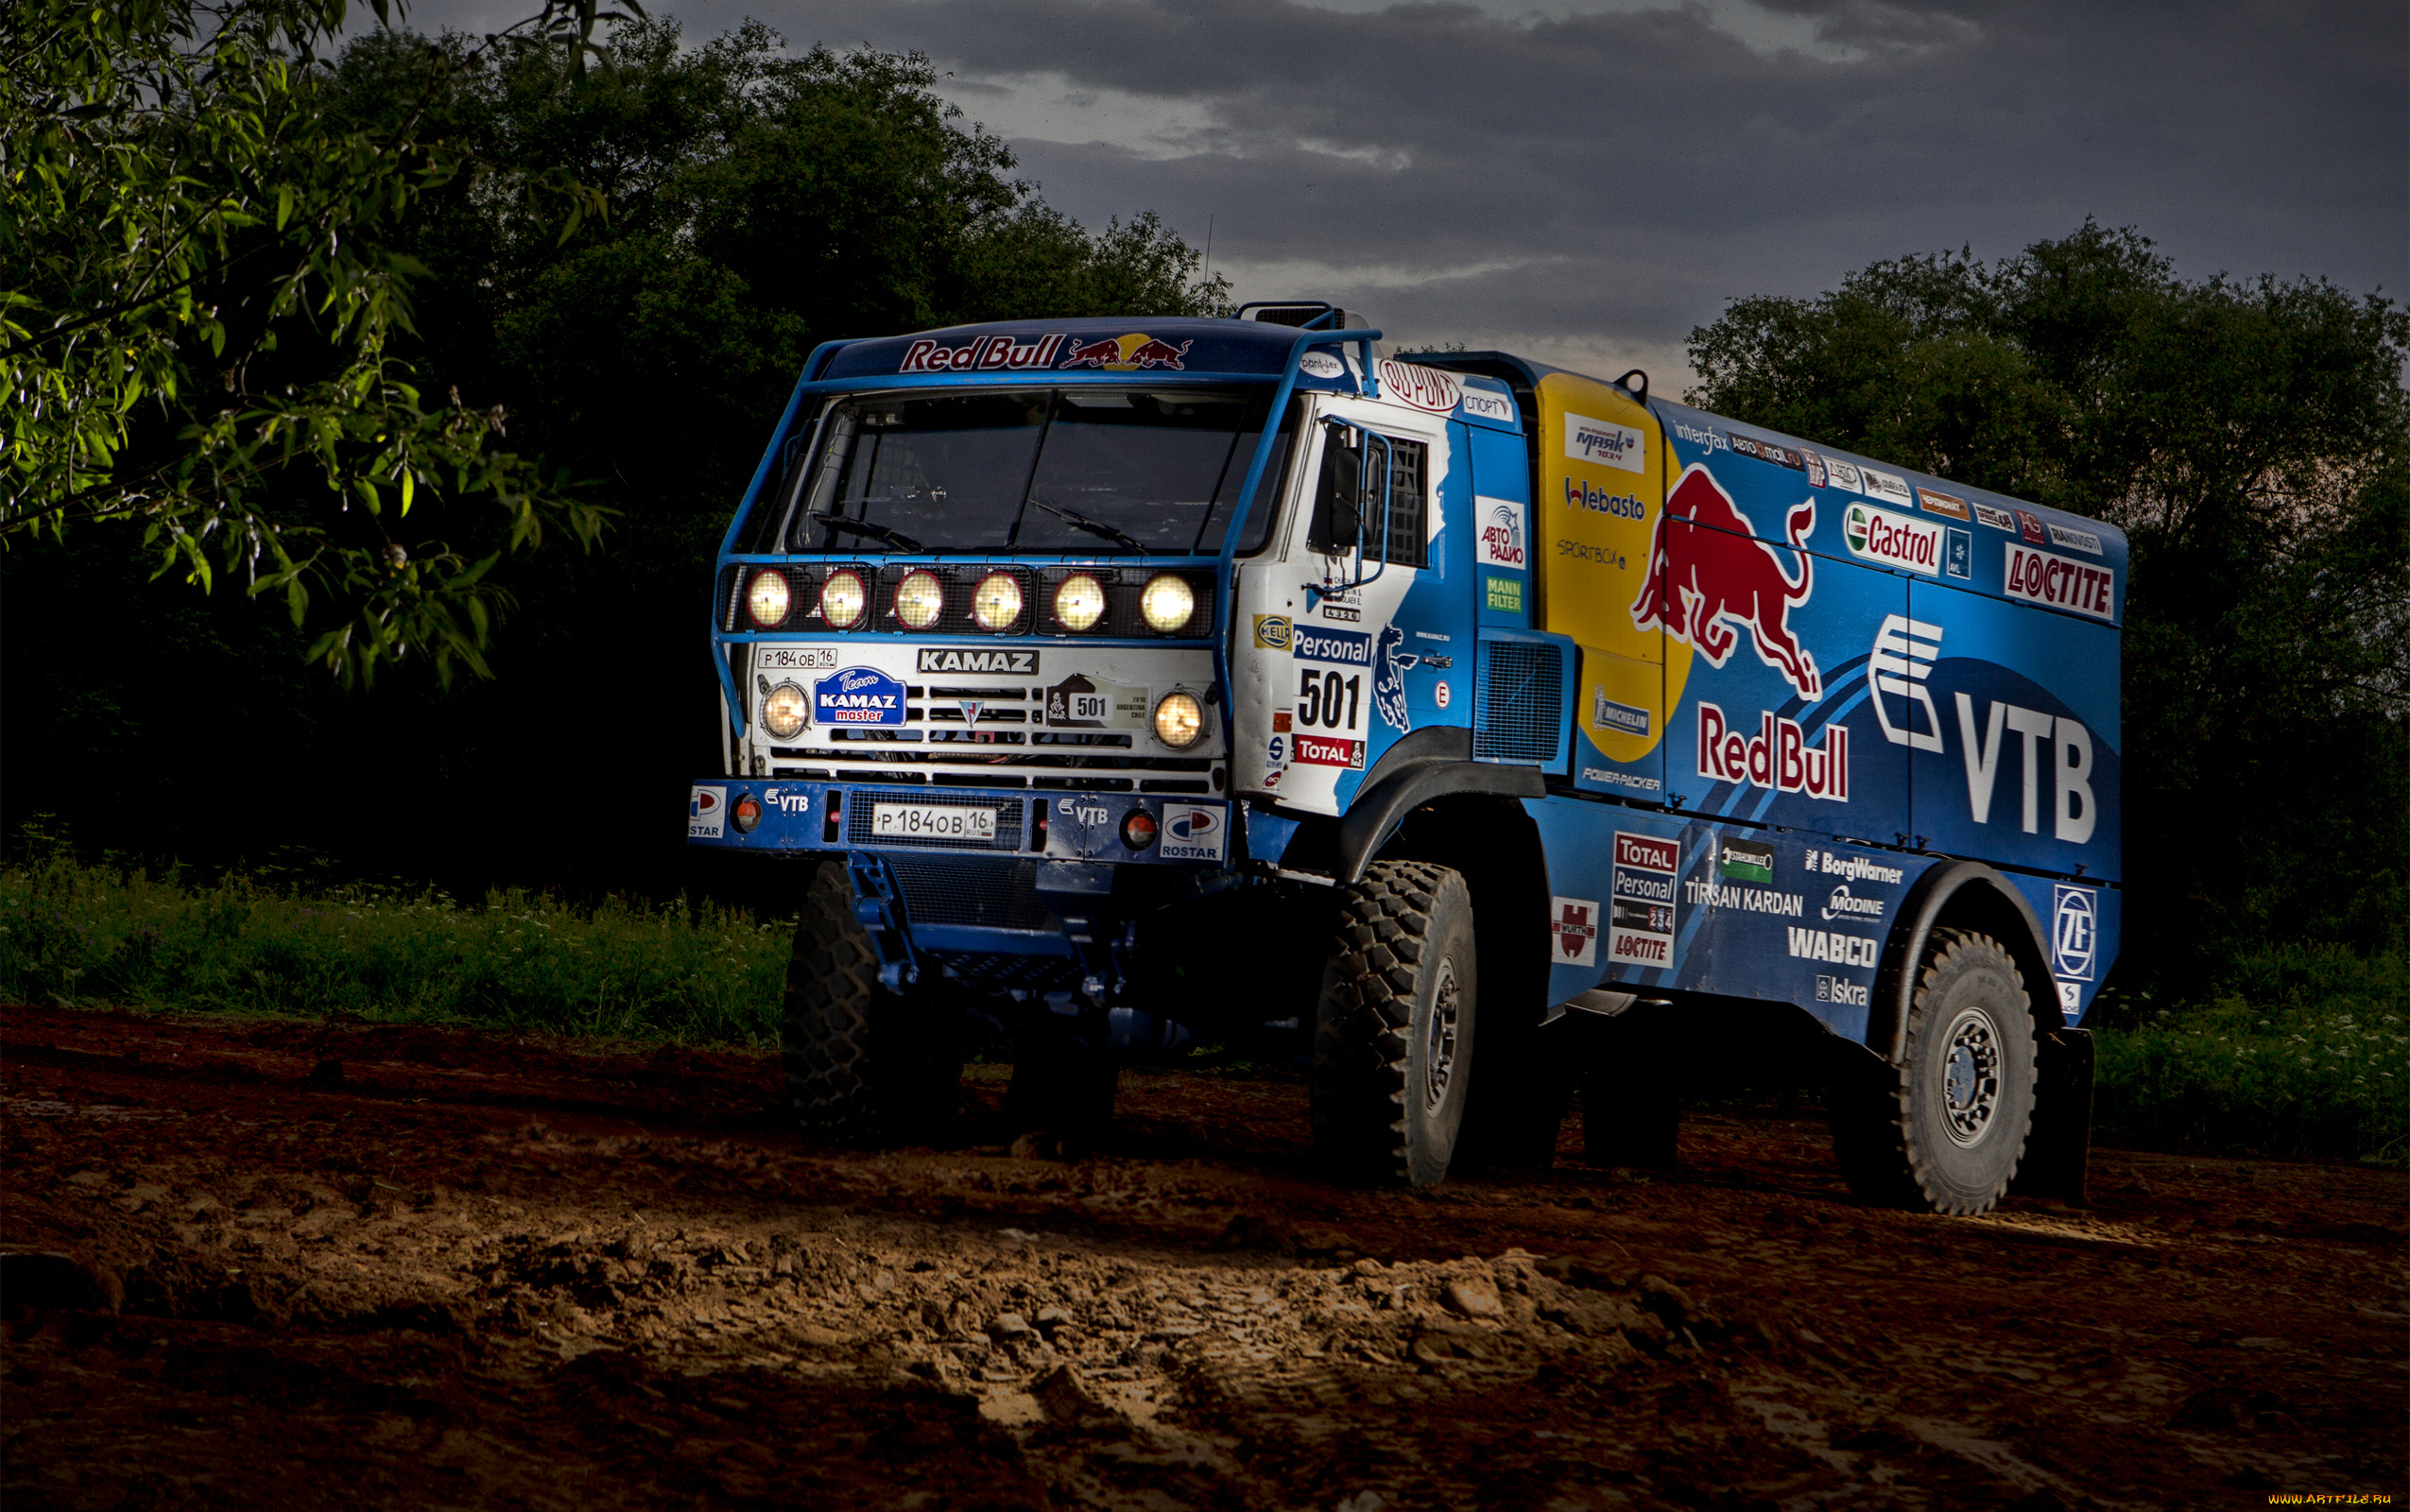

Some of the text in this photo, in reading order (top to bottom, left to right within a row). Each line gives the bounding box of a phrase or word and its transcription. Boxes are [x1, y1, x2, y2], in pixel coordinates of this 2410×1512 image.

[899, 334, 1068, 372] Red Bull
[1674, 420, 1730, 455] interfax
[1565, 476, 1645, 521] Webasto
[1481, 526, 1509, 545] АВТО
[1868, 515, 1937, 567] Castrol
[1490, 543, 1523, 564] РАДИО
[1558, 540, 1617, 565] SPORTBOX
[1488, 578, 1521, 596] MANN
[2008, 550, 2111, 612] LOCTITE
[1488, 593, 1521, 610] FILTER
[1328, 610, 1357, 620] 4326
[1261, 627, 1290, 641] HELLA
[819, 649, 833, 662] 16
[1293, 629, 1370, 662] Personal
[921, 651, 1033, 673] KAMAZ
[839, 671, 879, 693] Team
[819, 694, 897, 709] KAMAZ
[1298, 668, 1361, 730] 501
[1439, 685, 1447, 704] E
[835, 709, 884, 722] master
[1077, 697, 1106, 716] 501
[1605, 707, 1648, 729] MICHELIN
[1300, 740, 1349, 762] TOTAL
[1697, 701, 1849, 802] Red Bull
[1582, 767, 1661, 791] POWER-PACKER
[1954, 692, 2097, 844] VTB
[780, 796, 809, 812] VTB
[969, 811, 989, 829] 16
[1076, 806, 1109, 825] VTB
[1162, 845, 1217, 859] ROSTAR
[1620, 838, 1673, 868] TOTAL
[1821, 851, 1903, 885] BorgWarner
[1615, 870, 1674, 901] Personal
[1743, 888, 1803, 917] KARDAN
[1830, 895, 1885, 916] MODINE
[2059, 907, 2092, 958] ZF
[1614, 935, 1667, 960] LOCTITE
[1787, 925, 1878, 968] WABCO
[1831, 975, 1868, 1006] Iskra
